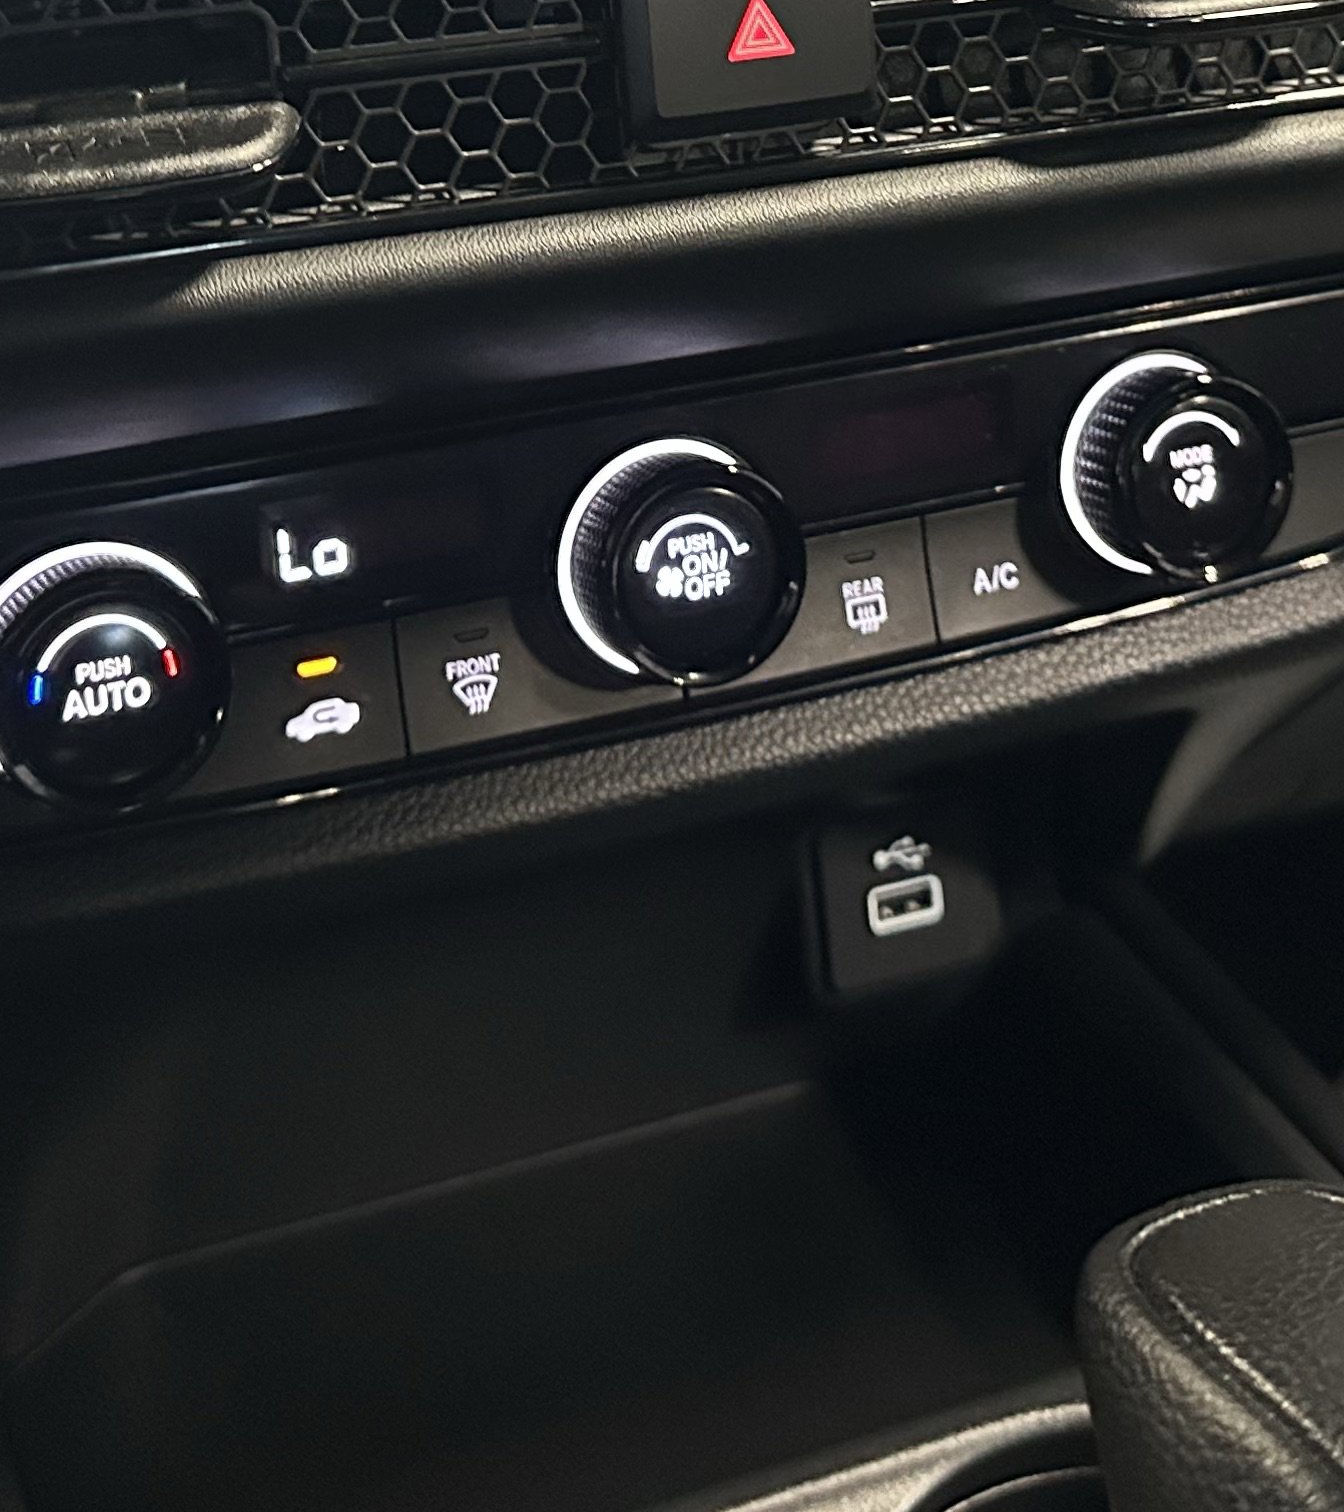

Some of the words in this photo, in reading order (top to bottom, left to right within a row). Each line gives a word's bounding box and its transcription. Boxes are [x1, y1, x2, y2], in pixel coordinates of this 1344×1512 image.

[276, 528, 348, 582] Lo
[668, 532, 715, 559] PUSH
[684, 570, 730, 601] OFF
[842, 576, 884, 598] REAR
[974, 561, 1020, 596] A/C
[75, 655, 131, 684] PUSH
[445, 653, 501, 679] FRONT
[62, 677, 151, 723] AUTO
